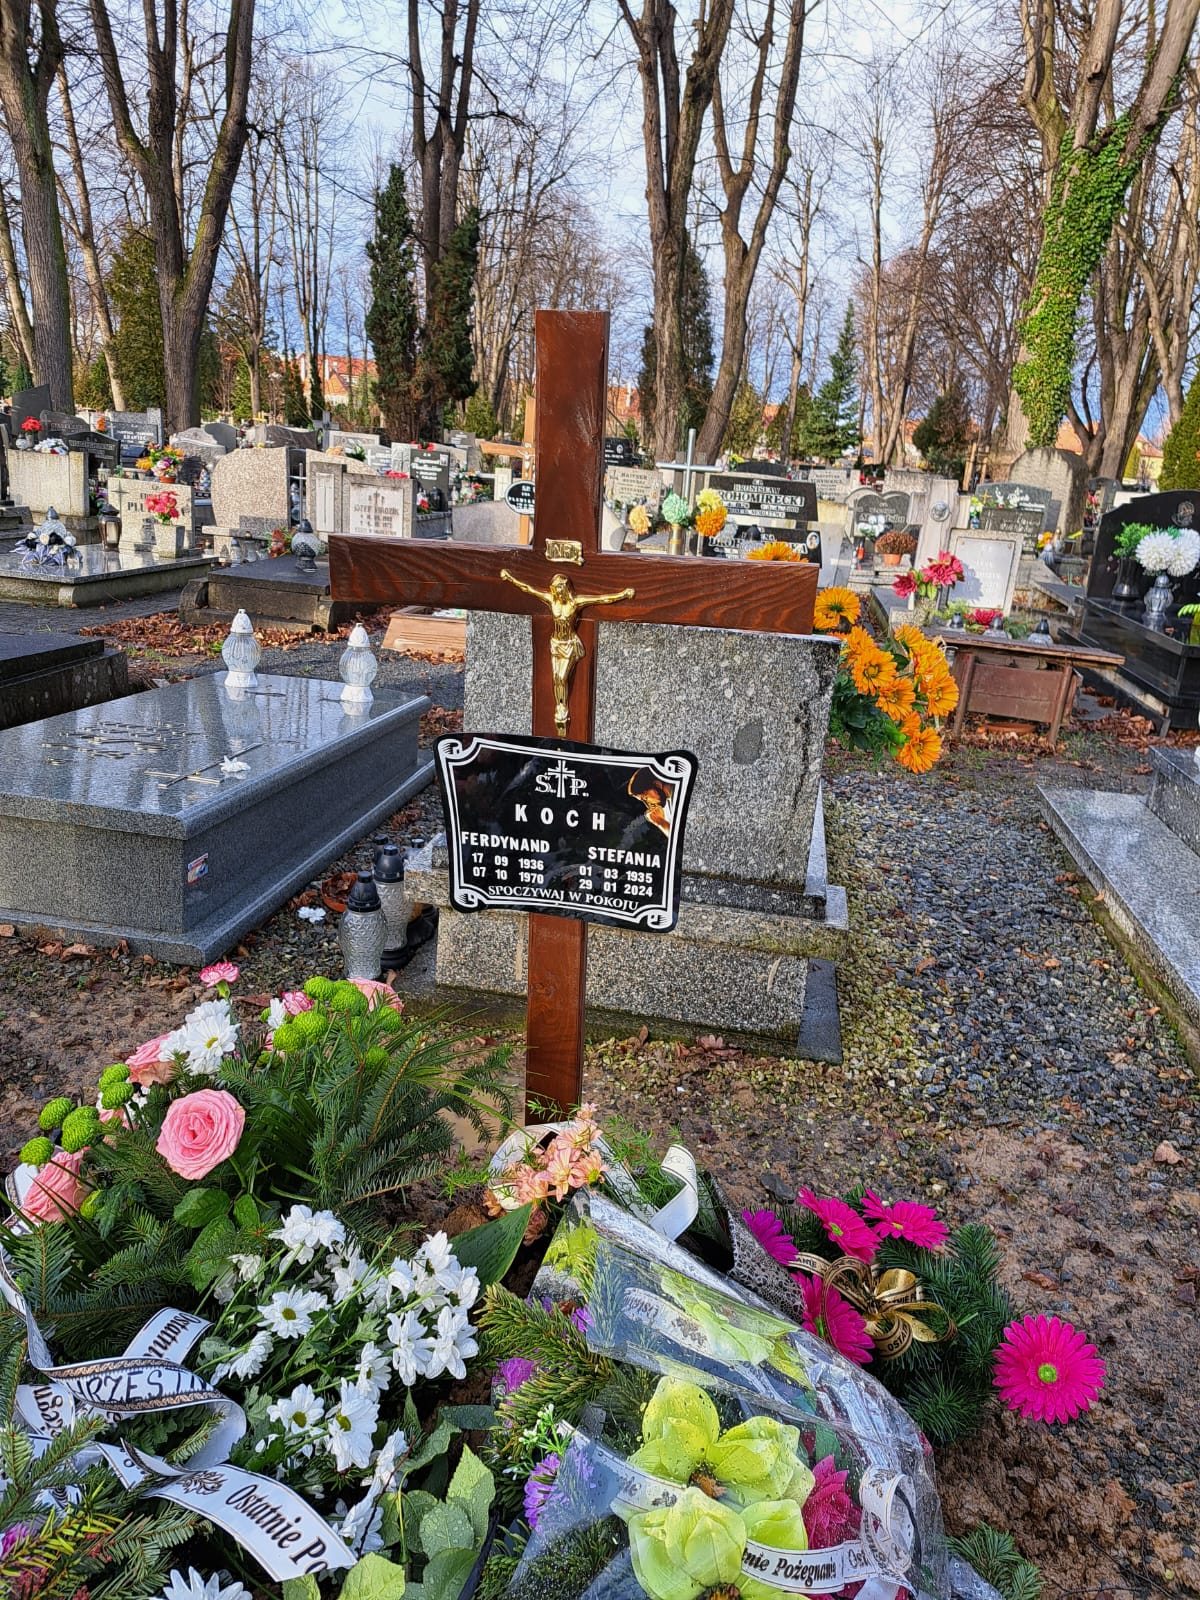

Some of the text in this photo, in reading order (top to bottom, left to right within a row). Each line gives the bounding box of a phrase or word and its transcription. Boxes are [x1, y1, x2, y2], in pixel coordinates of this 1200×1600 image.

[719, 490, 806, 508] ROHOMIRECKI
[515, 803, 606, 831] KOCH
[461, 831, 551, 854] FERDYNAND
[472, 852, 545, 871] 17 09 1936
[587, 846, 661, 869] STEFANIA
[472, 866, 545, 885] 07 10 1970
[579, 865, 653, 884] 01 03 1935
[488, 885, 640, 911] SPOCZYWAJ W POKOJU
[578, 878, 653, 898] 29 01 2024
[225, 1484, 302, 1549] Ostatnie
[771, 1557, 837, 1587] Pożegnanie
